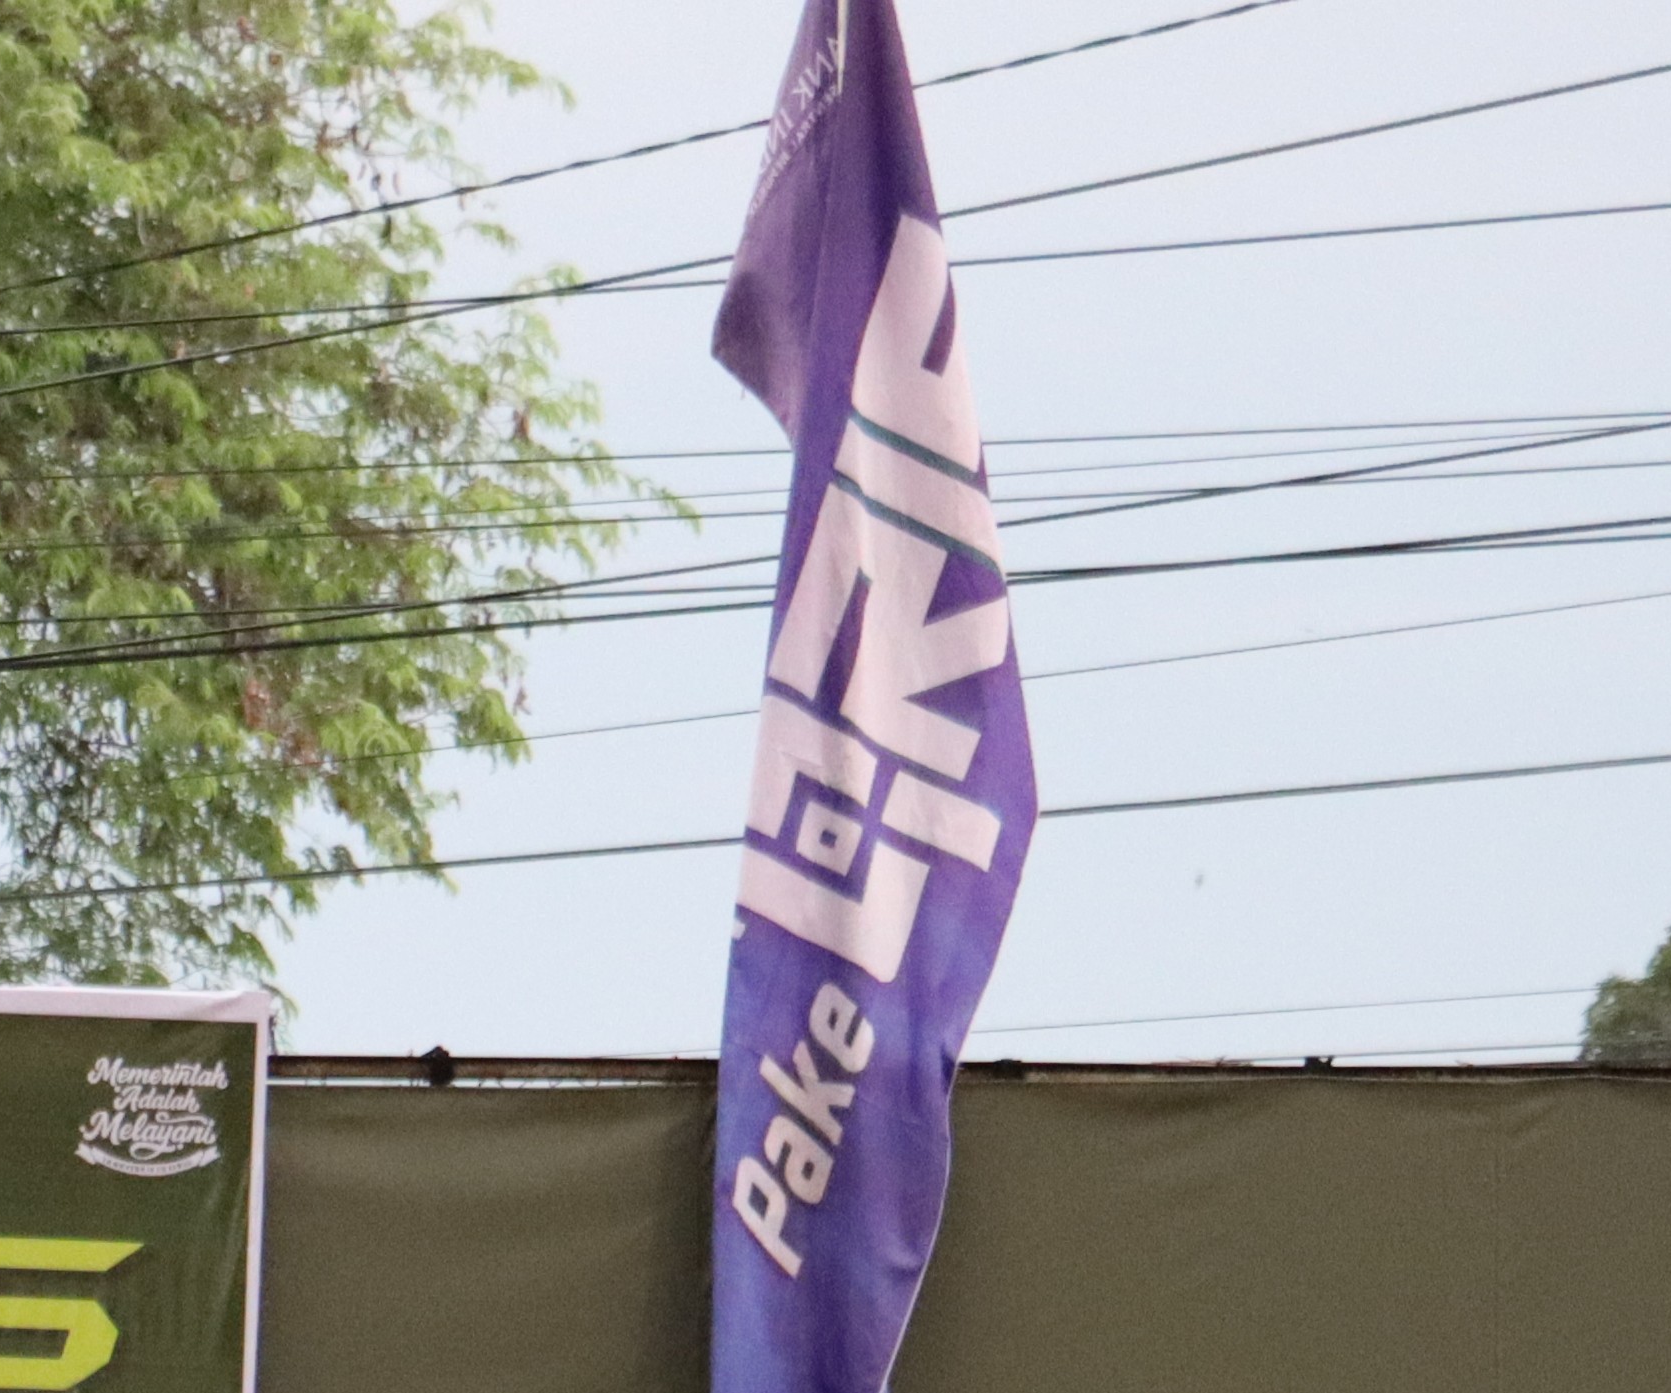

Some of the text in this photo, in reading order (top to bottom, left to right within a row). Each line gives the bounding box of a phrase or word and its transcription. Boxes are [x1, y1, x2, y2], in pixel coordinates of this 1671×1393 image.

[87, 1056, 229, 1090] Memerintah
[113, 1084, 200, 1113] Adalah
[79, 1110, 218, 1161] Melayani
[731, 979, 875, 1279] Pake
